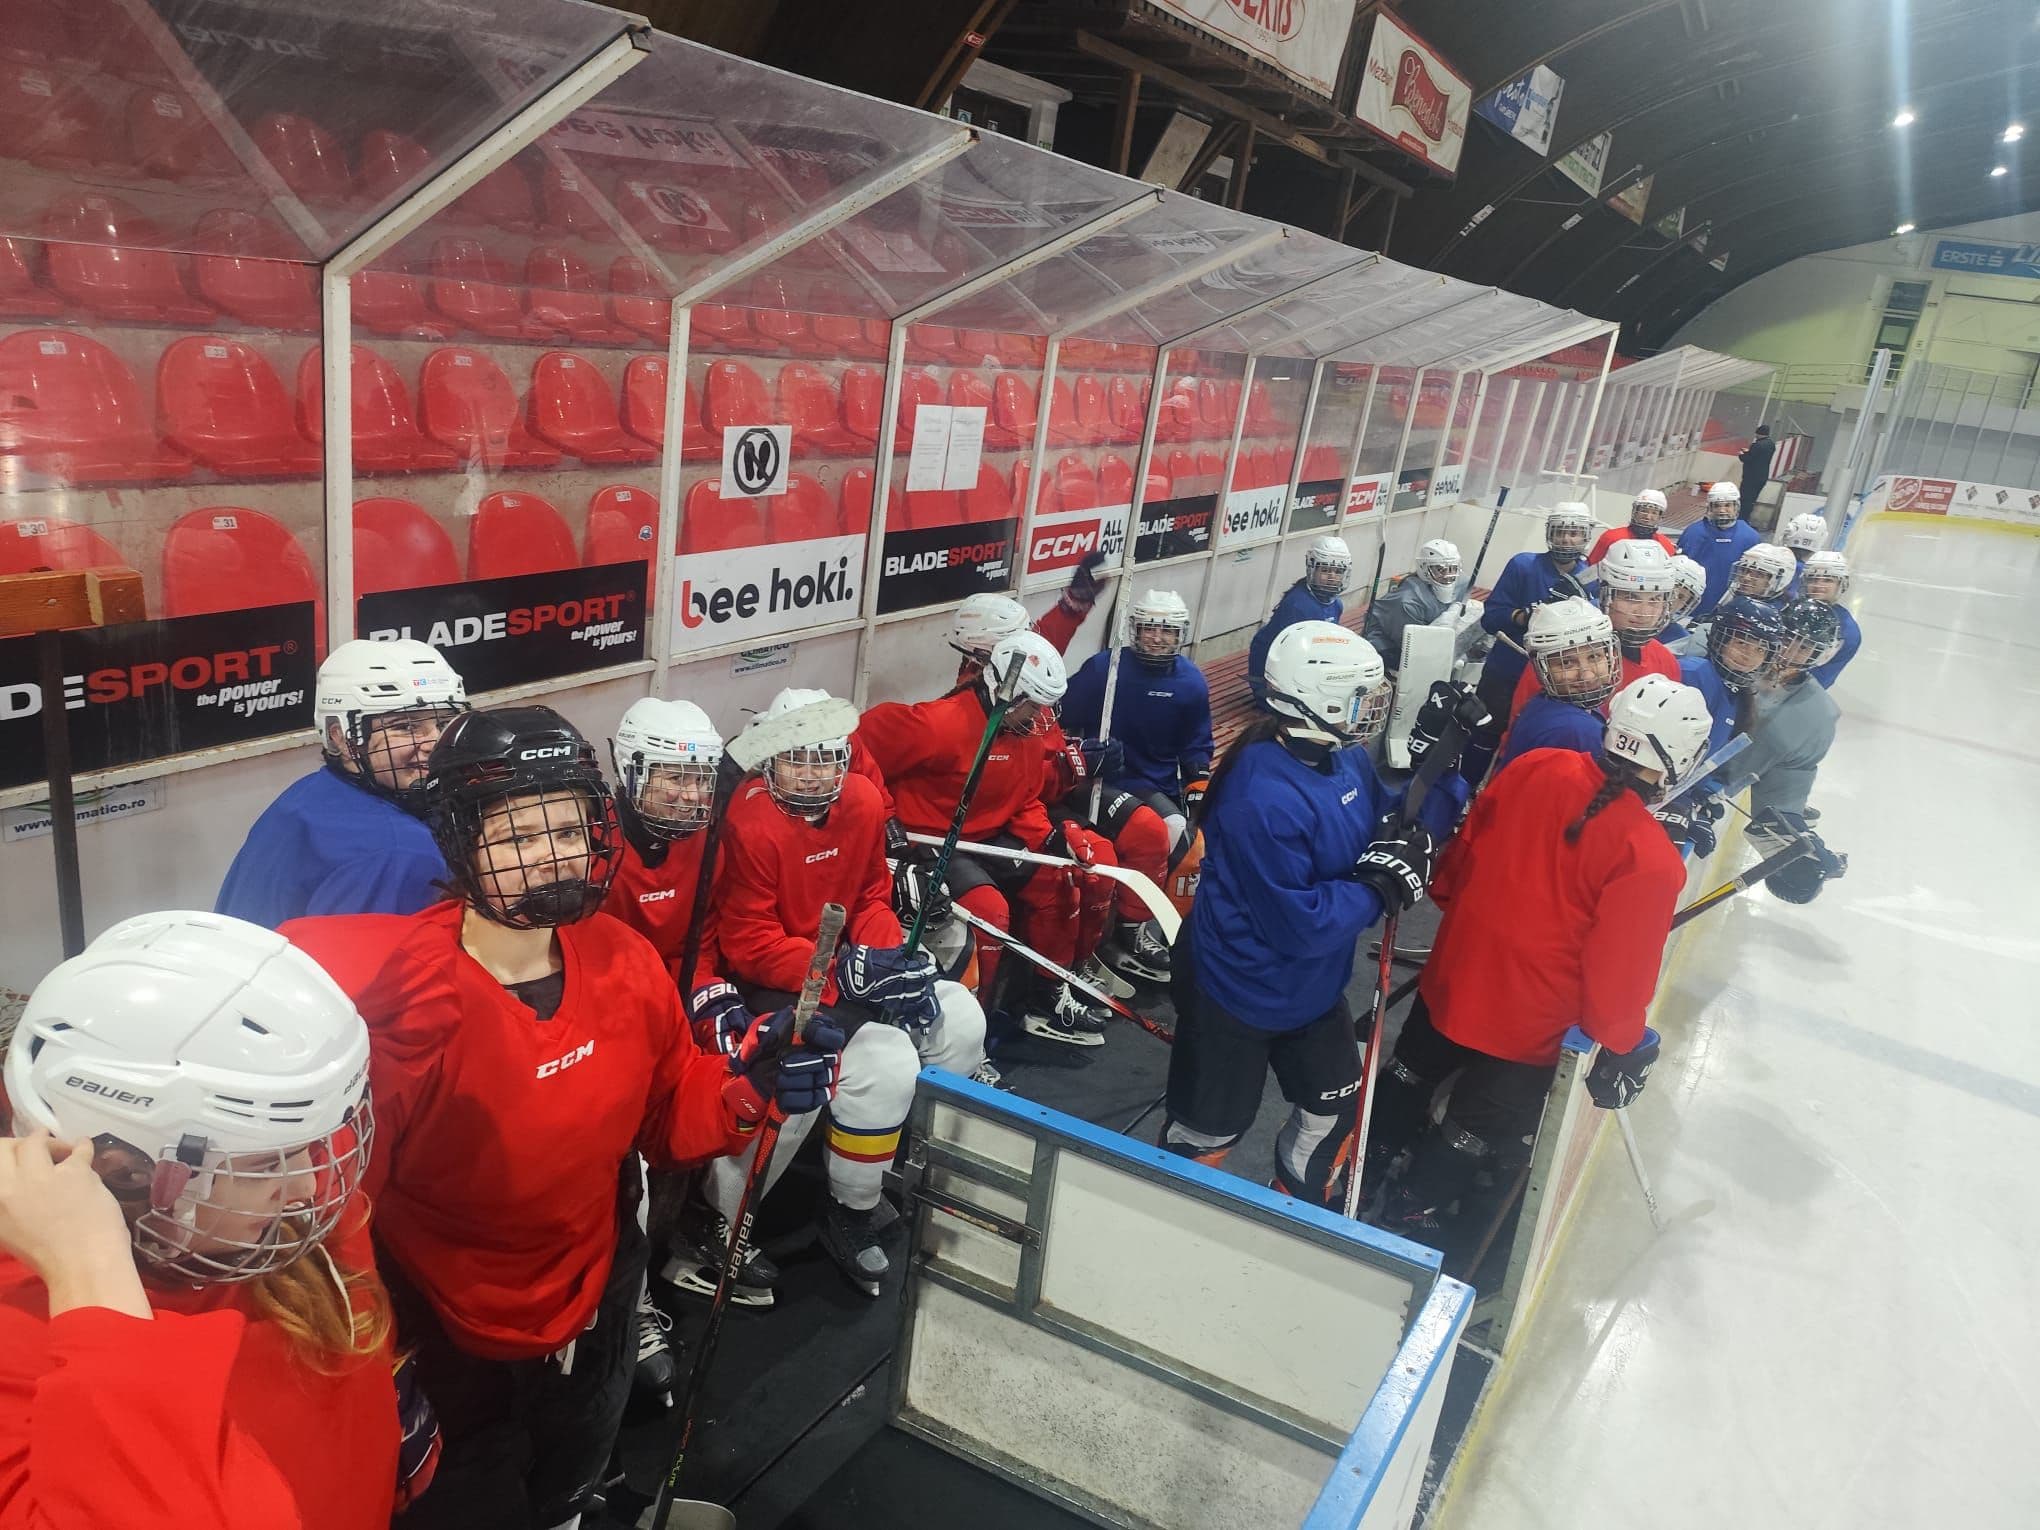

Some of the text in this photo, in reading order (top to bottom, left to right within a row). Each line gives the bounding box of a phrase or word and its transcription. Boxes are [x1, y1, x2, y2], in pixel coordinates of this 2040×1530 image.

[1941, 249, 1987, 266] ERSTE
[1348, 489, 1377, 507] CCM
[223, 518, 236, 529] 31
[1137, 511, 1210, 537] BLADESPORT
[1223, 507, 1249, 535] bee
[1250, 497, 1280, 529] hoki.
[1103, 520, 1122, 538] ALL
[1032, 531, 1097, 561] CCM
[885, 540, 1008, 577] BLADESPORT
[681, 556, 853, 629] bee hoki.
[584, 619, 624, 641] power
[600, 629, 637, 650] yours!
[197, 678, 281, 707] the power
[321, 697, 343, 705] CCM
[233, 689, 304, 718] is yours!
[520, 745, 571, 761] CCM
[1615, 734, 1641, 756] 34
[987, 754, 1010, 762] CCM
[1341, 787, 1359, 805] CCM
[806, 848, 839, 865] CCM
[639, 888, 676, 903] CCM
[536, 1039, 594, 1079] CCM
